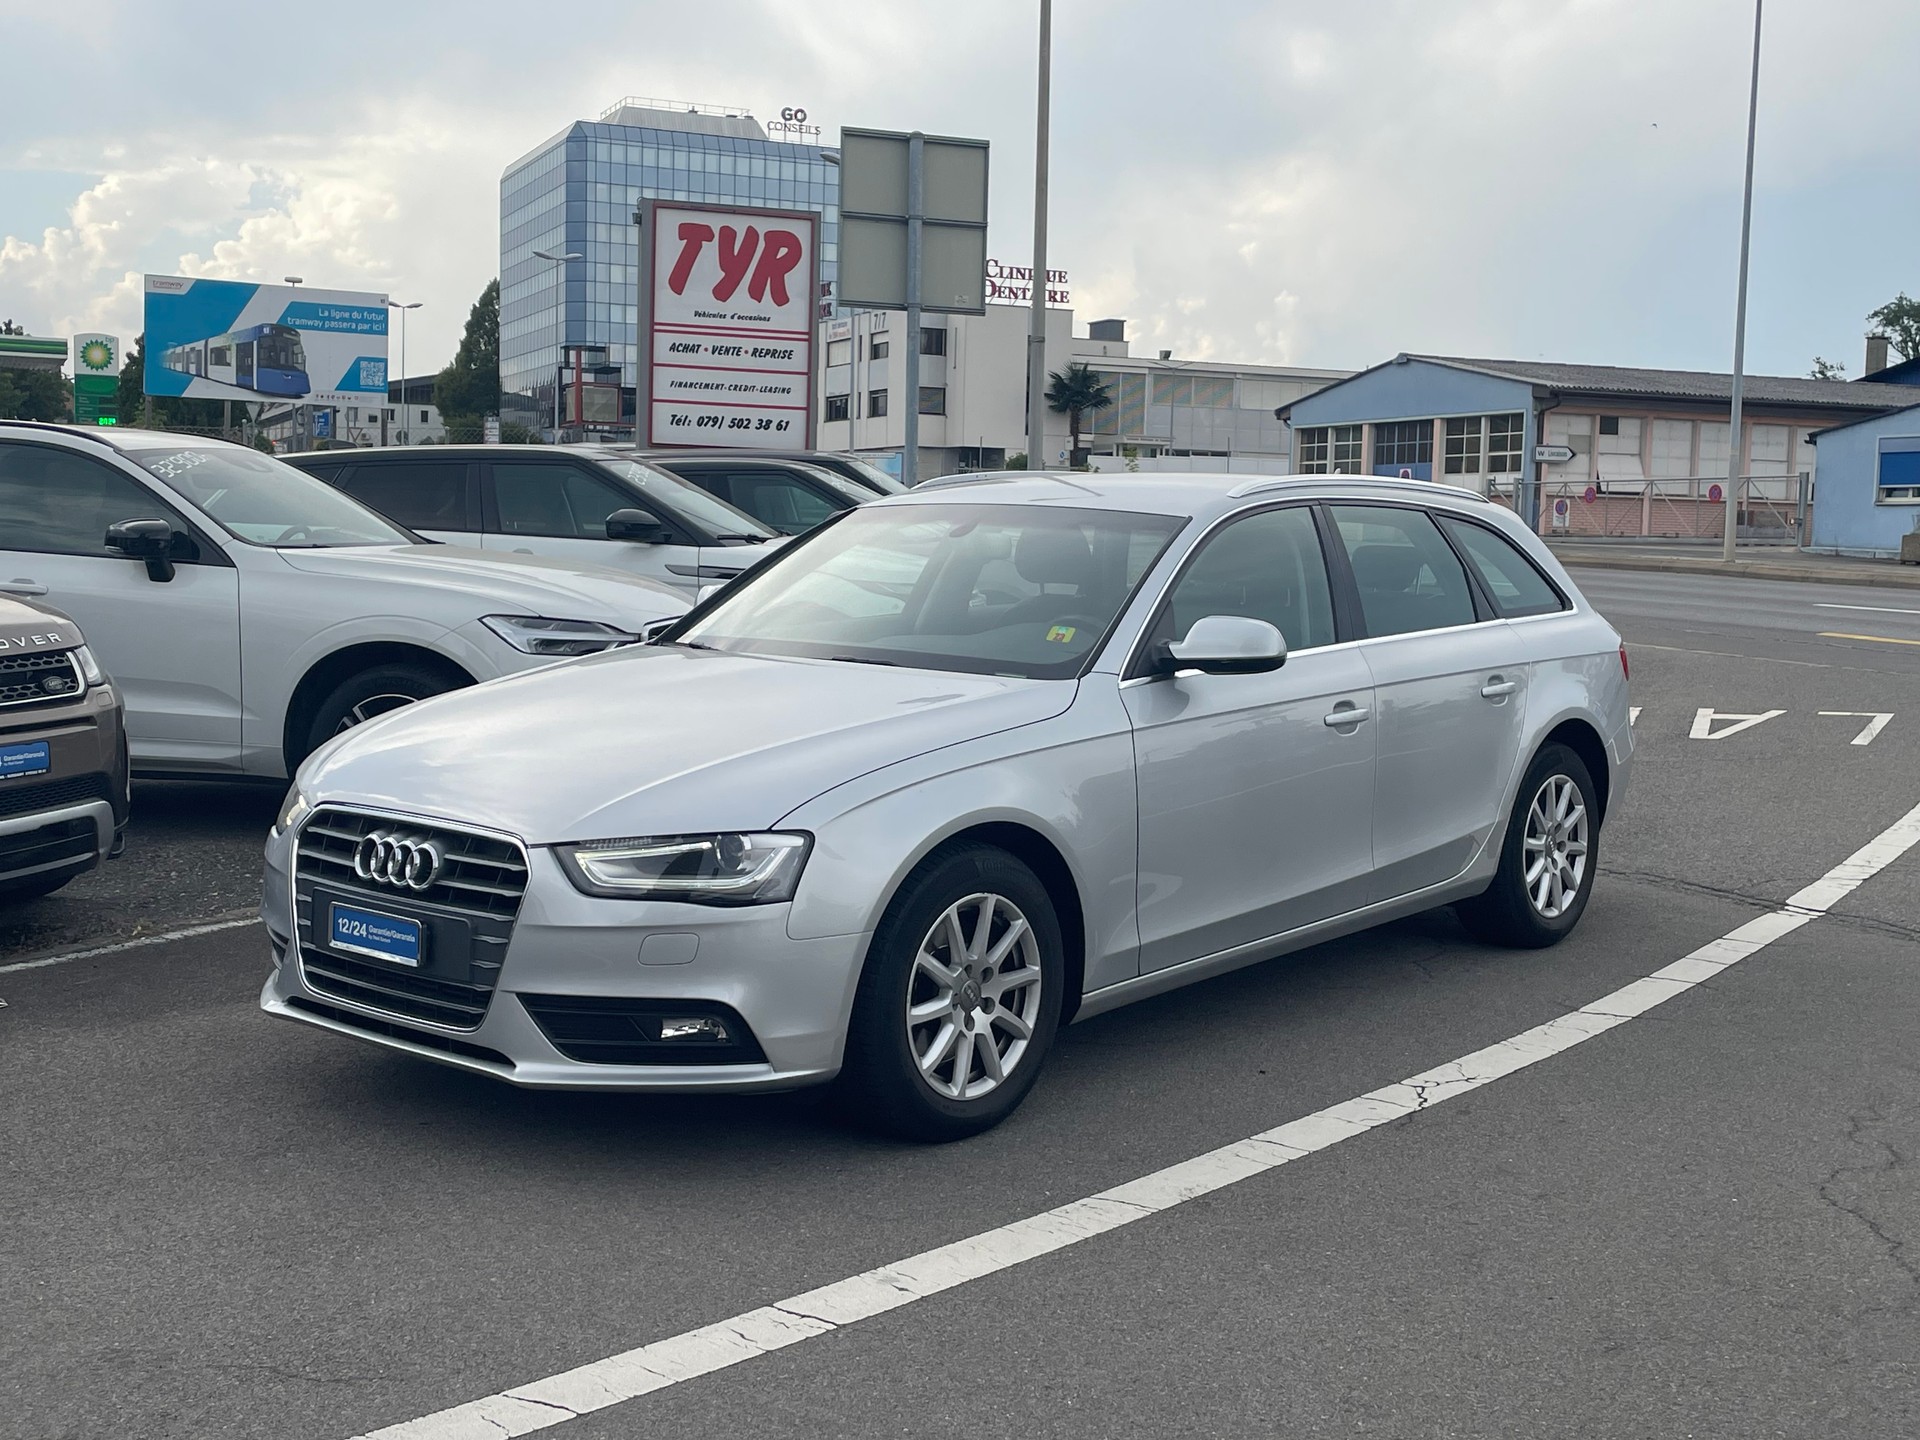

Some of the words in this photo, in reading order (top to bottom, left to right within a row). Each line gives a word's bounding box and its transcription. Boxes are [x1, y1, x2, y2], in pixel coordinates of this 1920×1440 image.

[781, 107, 807, 123] GO
[767, 121, 821, 135] CONSEILS
[668, 222, 803, 307] TYR
[985, 259, 1068, 283] CLINIUE
[319, 309, 329, 317] La
[330, 309, 350, 319] ligne
[352, 310, 361, 319] du
[363, 311, 385, 321] futur
[693, 310, 727, 320] Véhicules
[730, 312, 771, 322] d'occasions
[287, 317, 322, 328] tramway
[324, 320, 356, 330] passera
[357, 322, 371, 332] par
[668, 342, 702, 354] ACHAT
[711, 344, 743, 357] VENTE
[750, 347, 794, 360] REPRISE
[669, 414, 692, 427] Tél:
[728, 417, 751, 430] 502
[755, 418, 773, 431] 38
[775, 419, 790, 432] 61
[337, 917, 367, 938] 12/24
